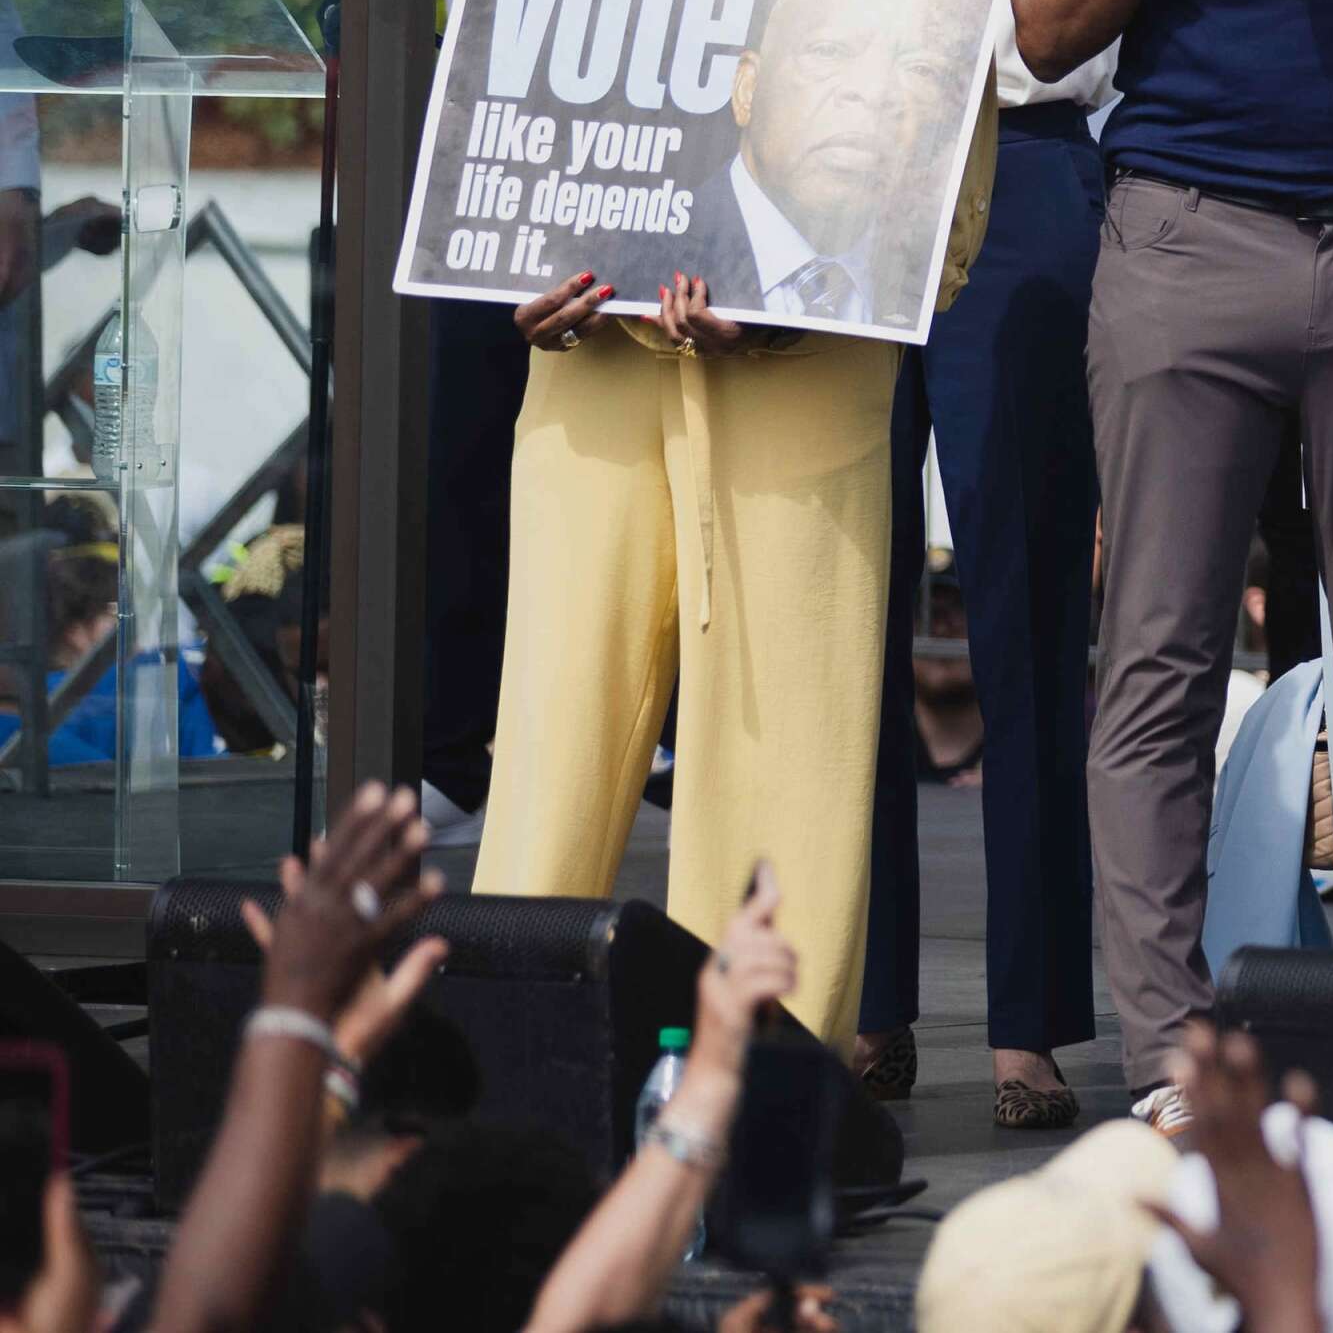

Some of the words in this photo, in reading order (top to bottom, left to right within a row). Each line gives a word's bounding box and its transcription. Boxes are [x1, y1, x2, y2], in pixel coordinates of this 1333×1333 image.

[466, 100, 556, 164] like
[566, 119, 683, 176] your
[455, 162, 523, 221] life
[529, 169, 694, 236] depends
[446, 228, 501, 272] on
[509, 225, 554, 278] it.
